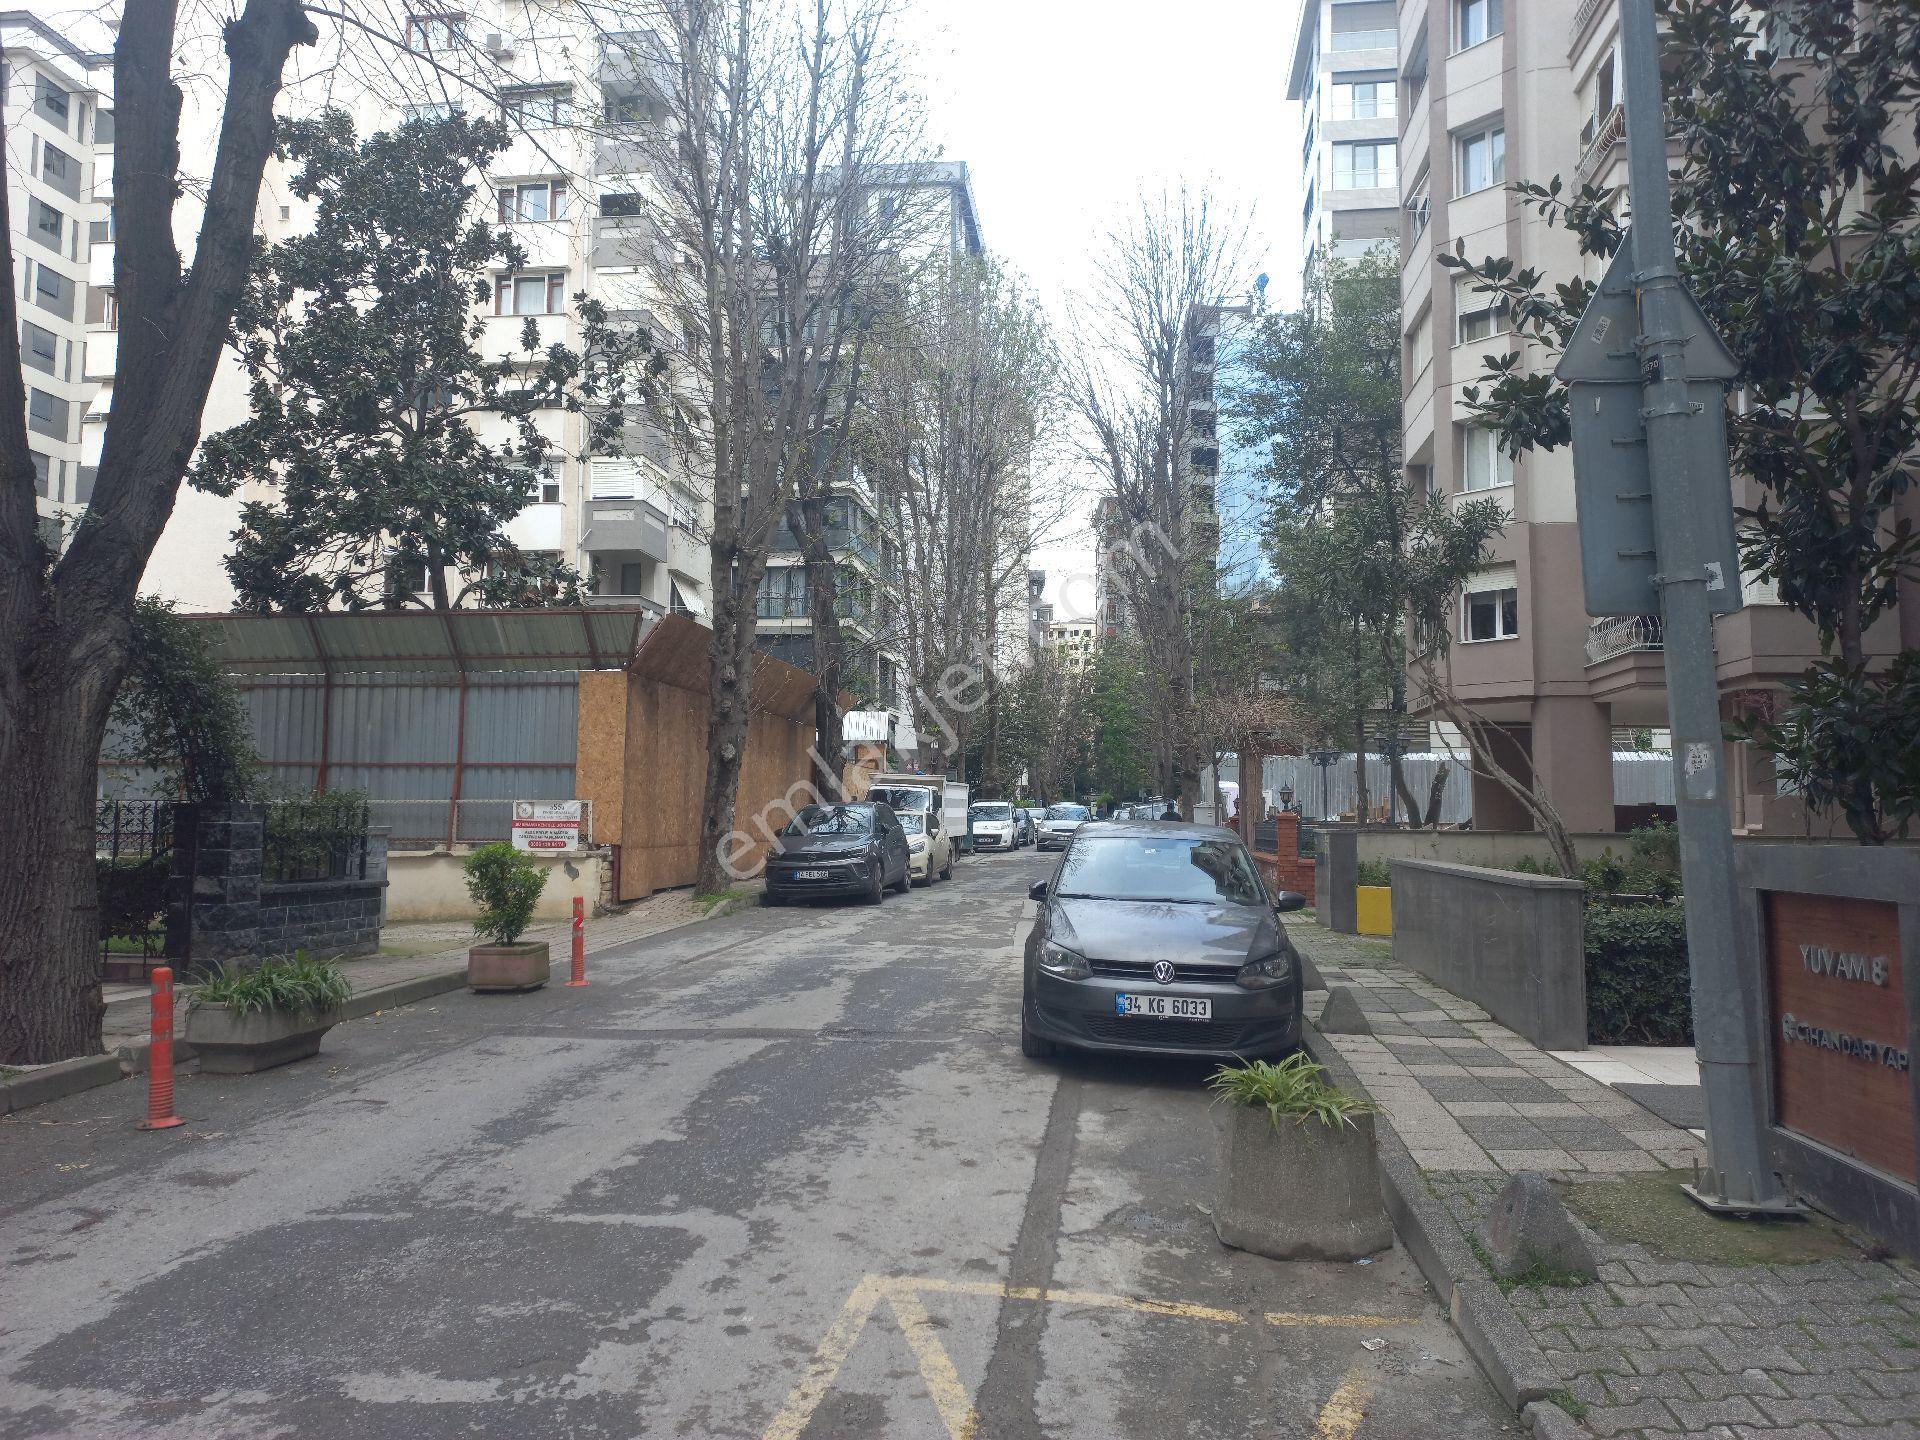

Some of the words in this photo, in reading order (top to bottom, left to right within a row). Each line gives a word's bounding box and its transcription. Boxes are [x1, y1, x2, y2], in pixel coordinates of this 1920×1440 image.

[1800, 944, 1868, 982] YUVAM
[1125, 996, 1141, 1012] 34
[1148, 998, 1165, 1014] KG
[1172, 1000, 1207, 1016] 6033
